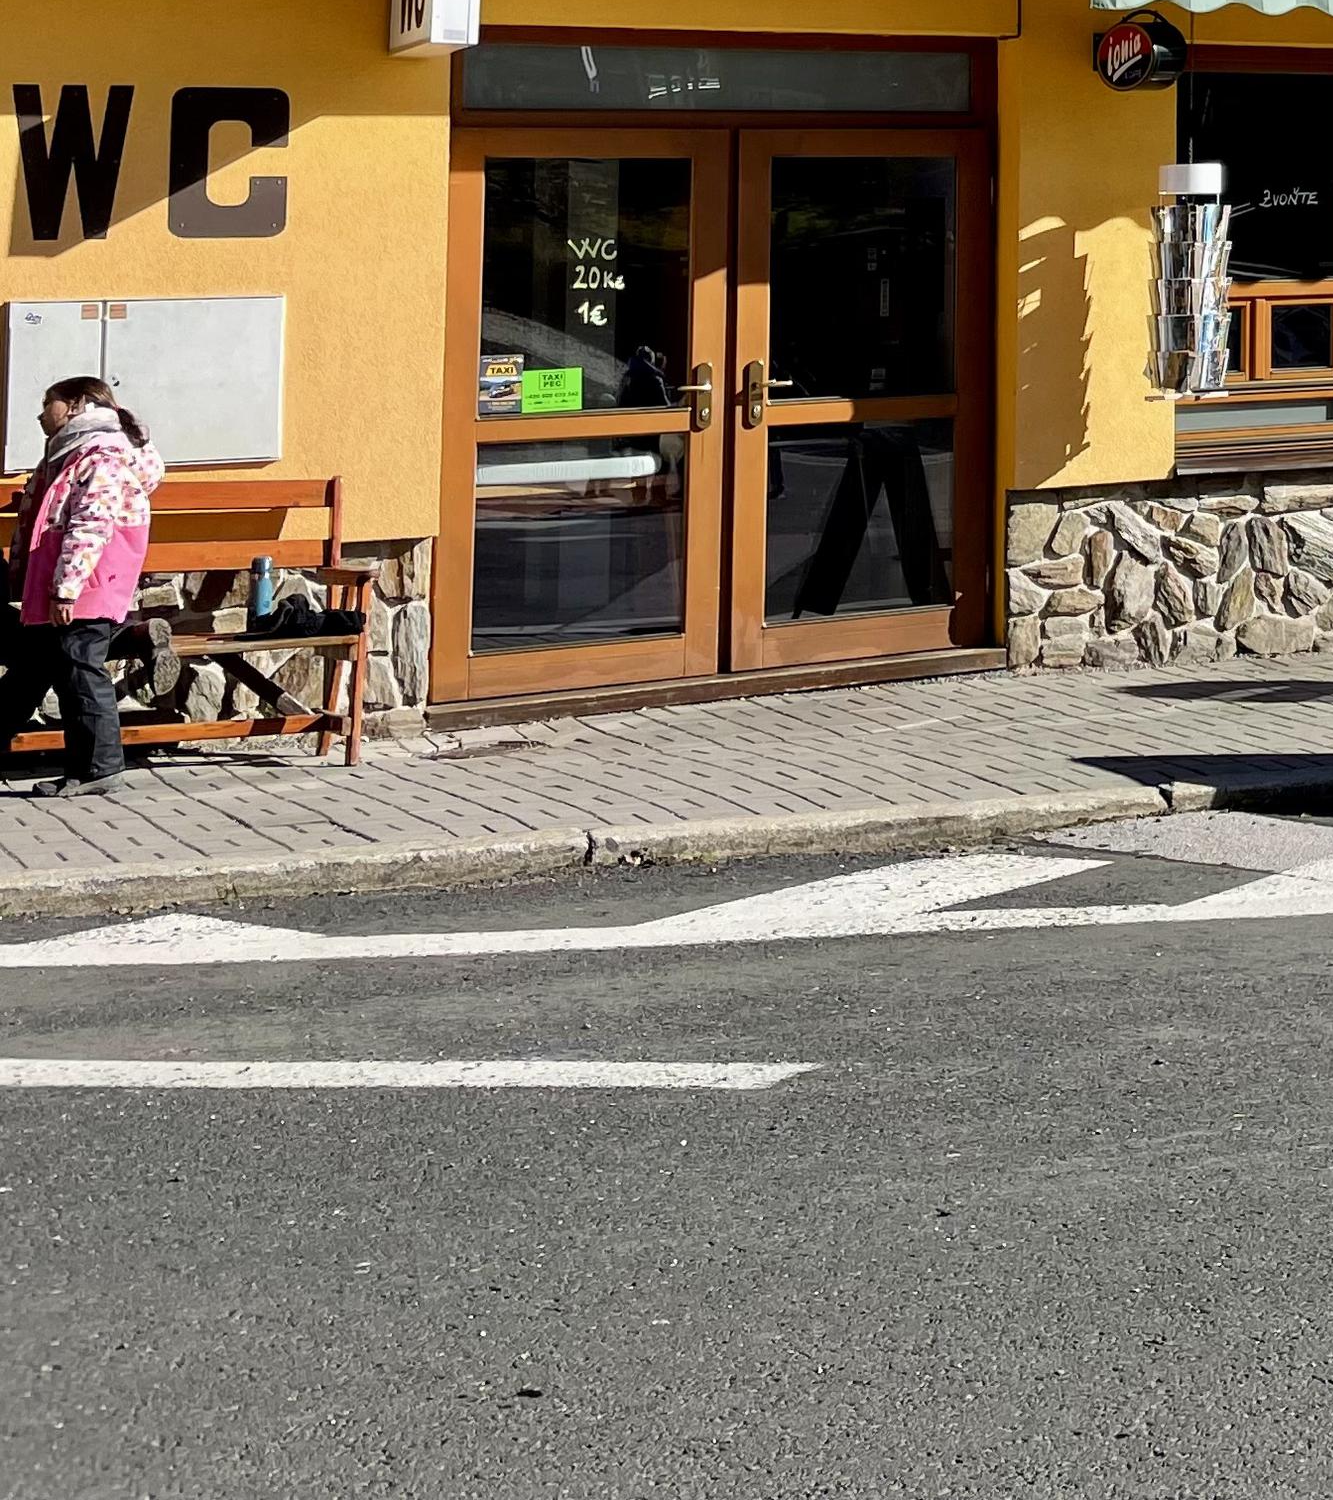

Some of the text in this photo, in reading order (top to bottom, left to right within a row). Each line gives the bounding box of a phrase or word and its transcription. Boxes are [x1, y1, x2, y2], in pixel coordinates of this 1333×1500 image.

[568, 238, 618, 261] WC
[490, 366, 515, 375] TAXI
[542, 373, 564, 381] TAXI
